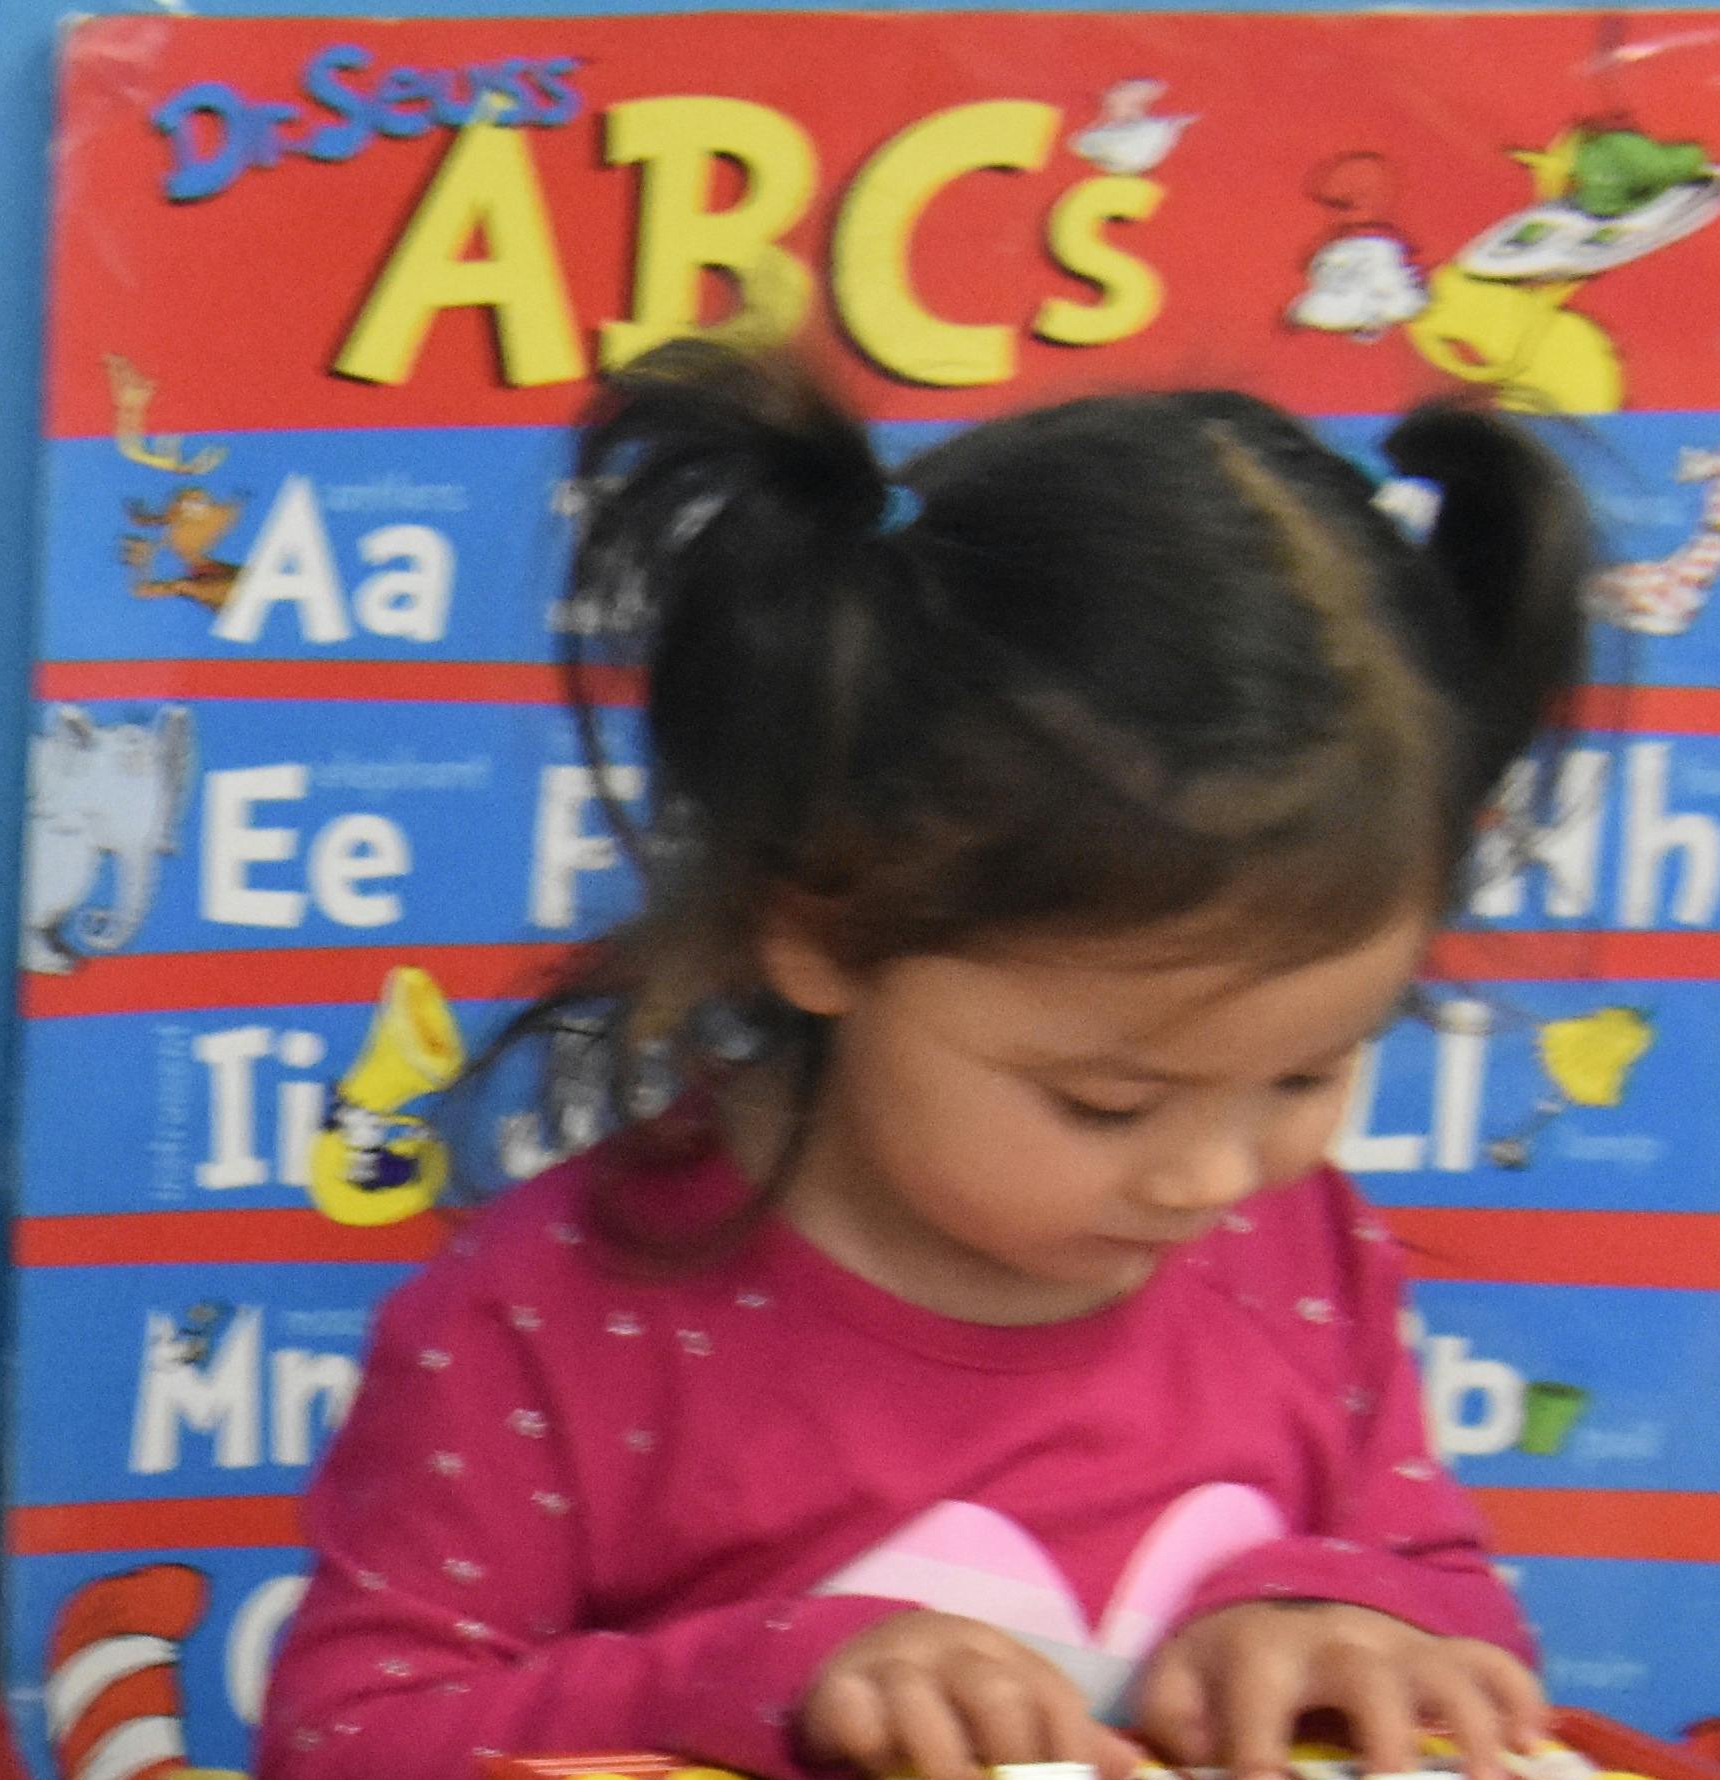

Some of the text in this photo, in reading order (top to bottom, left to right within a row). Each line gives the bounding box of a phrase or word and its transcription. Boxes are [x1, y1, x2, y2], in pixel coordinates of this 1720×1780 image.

[302, 43, 585, 164] Seuss
[333, 92, 1165, 387] ABCs
[210, 474, 455, 643] Aa
[201, 763, 413, 928] Ee
[527, 763, 705, 926] F
[191, 1026, 328, 1190] Ii
